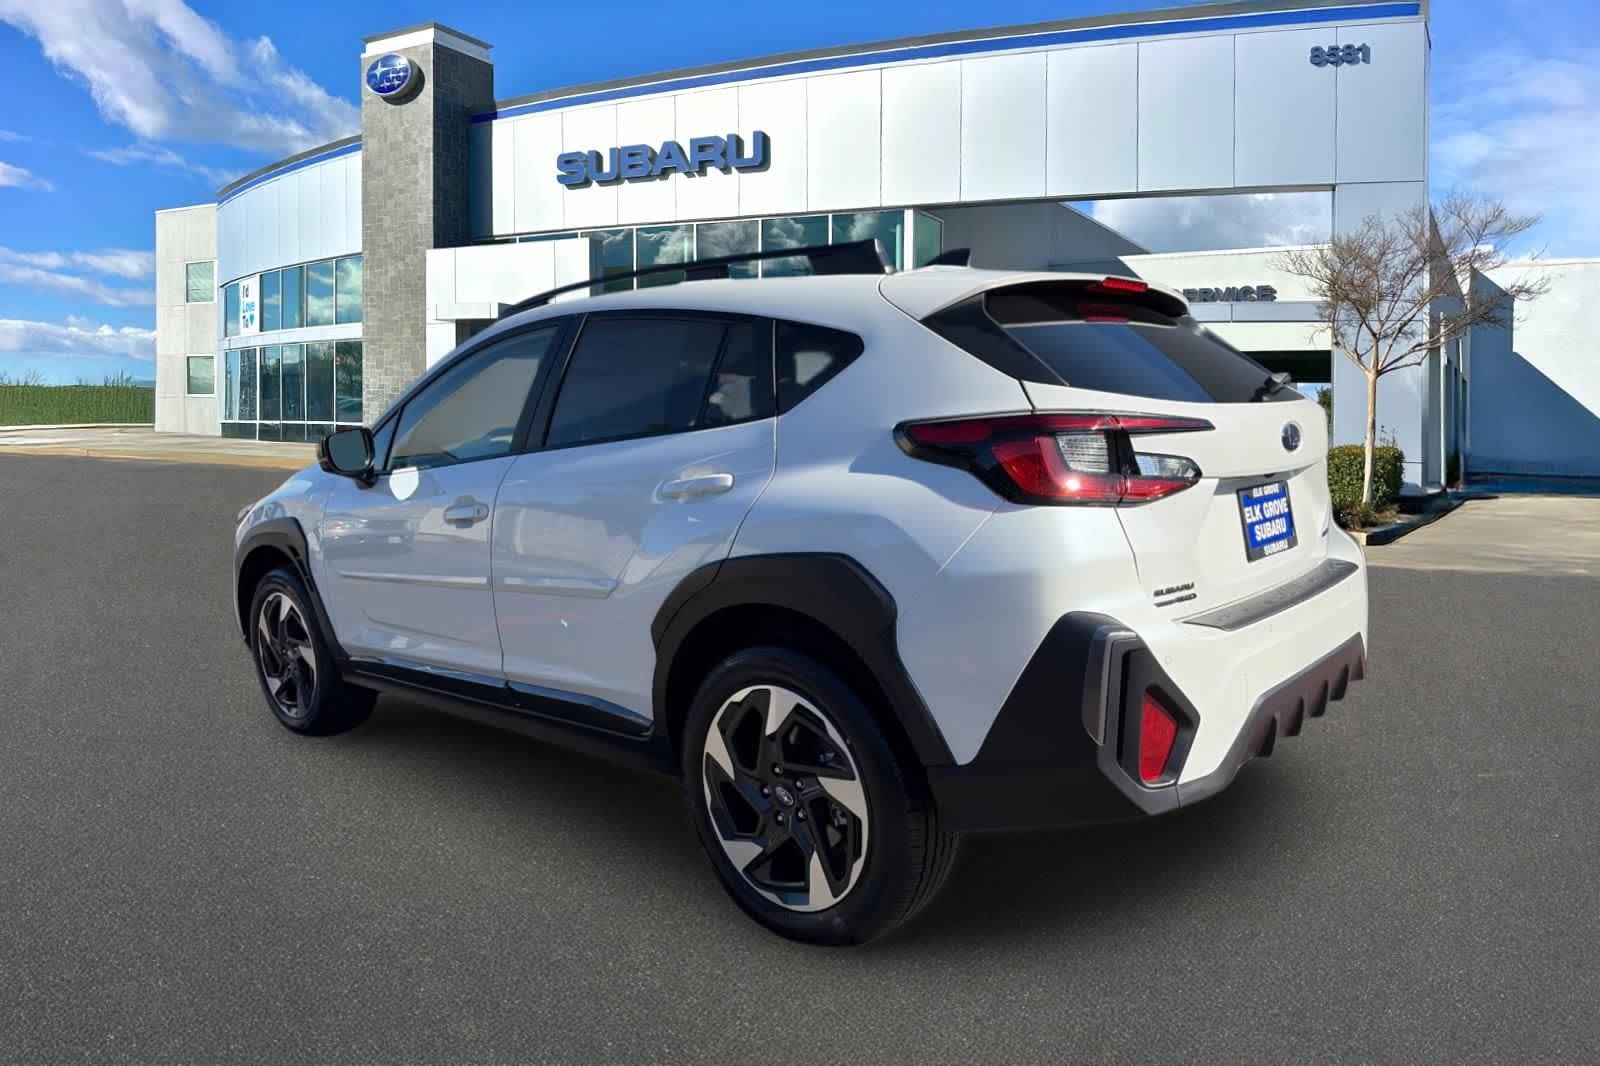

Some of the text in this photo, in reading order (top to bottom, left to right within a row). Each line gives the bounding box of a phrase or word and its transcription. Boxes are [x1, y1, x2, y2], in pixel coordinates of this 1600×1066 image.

[556, 130, 771, 190] SUBARU
[1174, 285, 1278, 303] ERVICE
[1244, 497, 1289, 523] ELK GROVE
[1254, 517, 1287, 541] SUBARU
